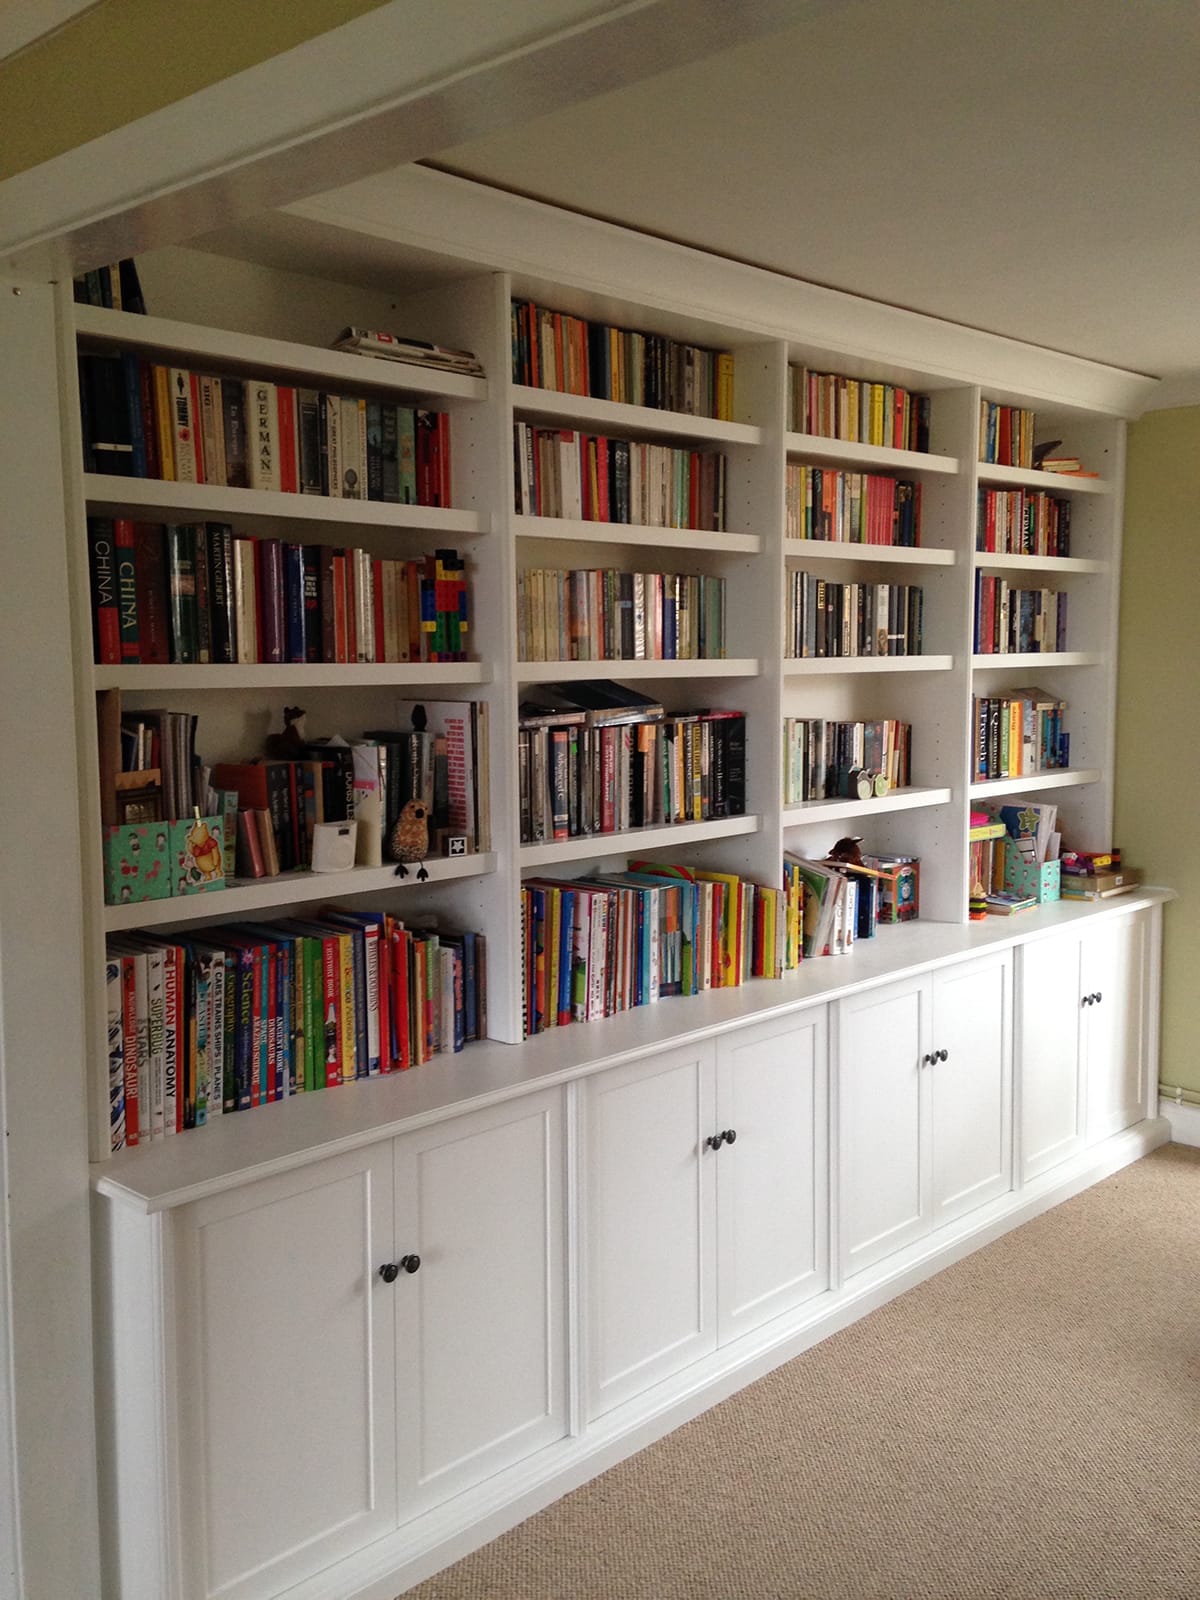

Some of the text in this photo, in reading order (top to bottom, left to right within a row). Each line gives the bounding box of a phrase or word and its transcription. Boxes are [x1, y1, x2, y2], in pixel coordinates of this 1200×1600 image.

[176, 397, 189, 427] TOMMY
[257, 388, 271, 471] GERMAN
[95, 541, 113, 604] CHINA
[119, 561, 137, 629] CHINA
[212, 532, 224, 606] MARTIN GILBERT
[979, 712, 987, 761] French
[990, 711, 999, 769] Quotations
[326, 947, 334, 977] HISTORY
[368, 940, 378, 969] WHALES
[225, 974, 236, 1033] Geography
[241, 971, 253, 1025] Science
[369, 977, 378, 1012] DOLPHINS
[137, 1026, 148, 1067] STARS
[151, 997, 164, 1055] SUPERBUG
[165, 966, 176, 1098] HUMAN ANATOMY
[214, 1031, 222, 1057] SHIPS
[253, 1015, 261, 1051] AMAZING
[124, 1035, 138, 1100] DINOSAUR!
[213, 1066, 221, 1100] PLANES
